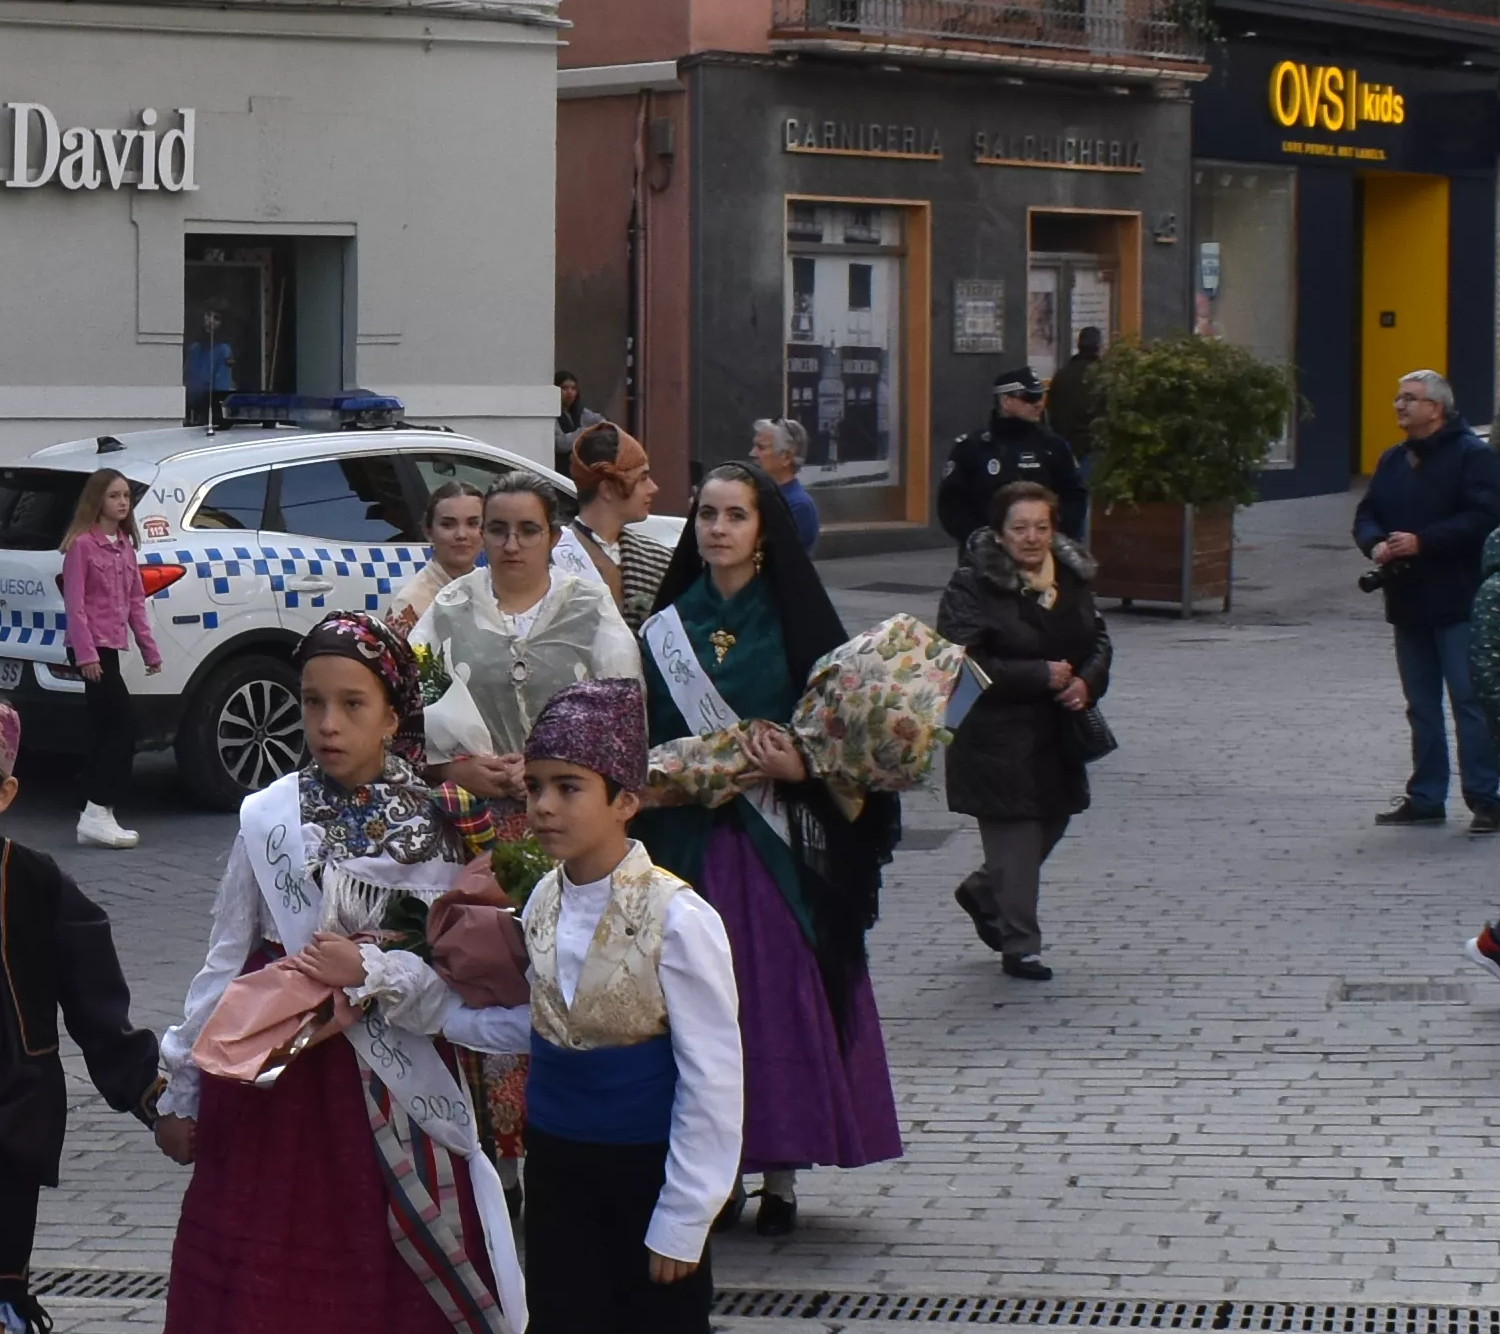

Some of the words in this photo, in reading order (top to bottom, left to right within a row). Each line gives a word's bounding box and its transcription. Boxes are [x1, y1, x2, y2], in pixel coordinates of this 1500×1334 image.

[1271, 60, 1345, 132] OVS
[1362, 83, 1404, 124] kids
[4, 101, 200, 193] David
[150, 526, 165, 537] 112
[410, 1095, 471, 1127] 2023
